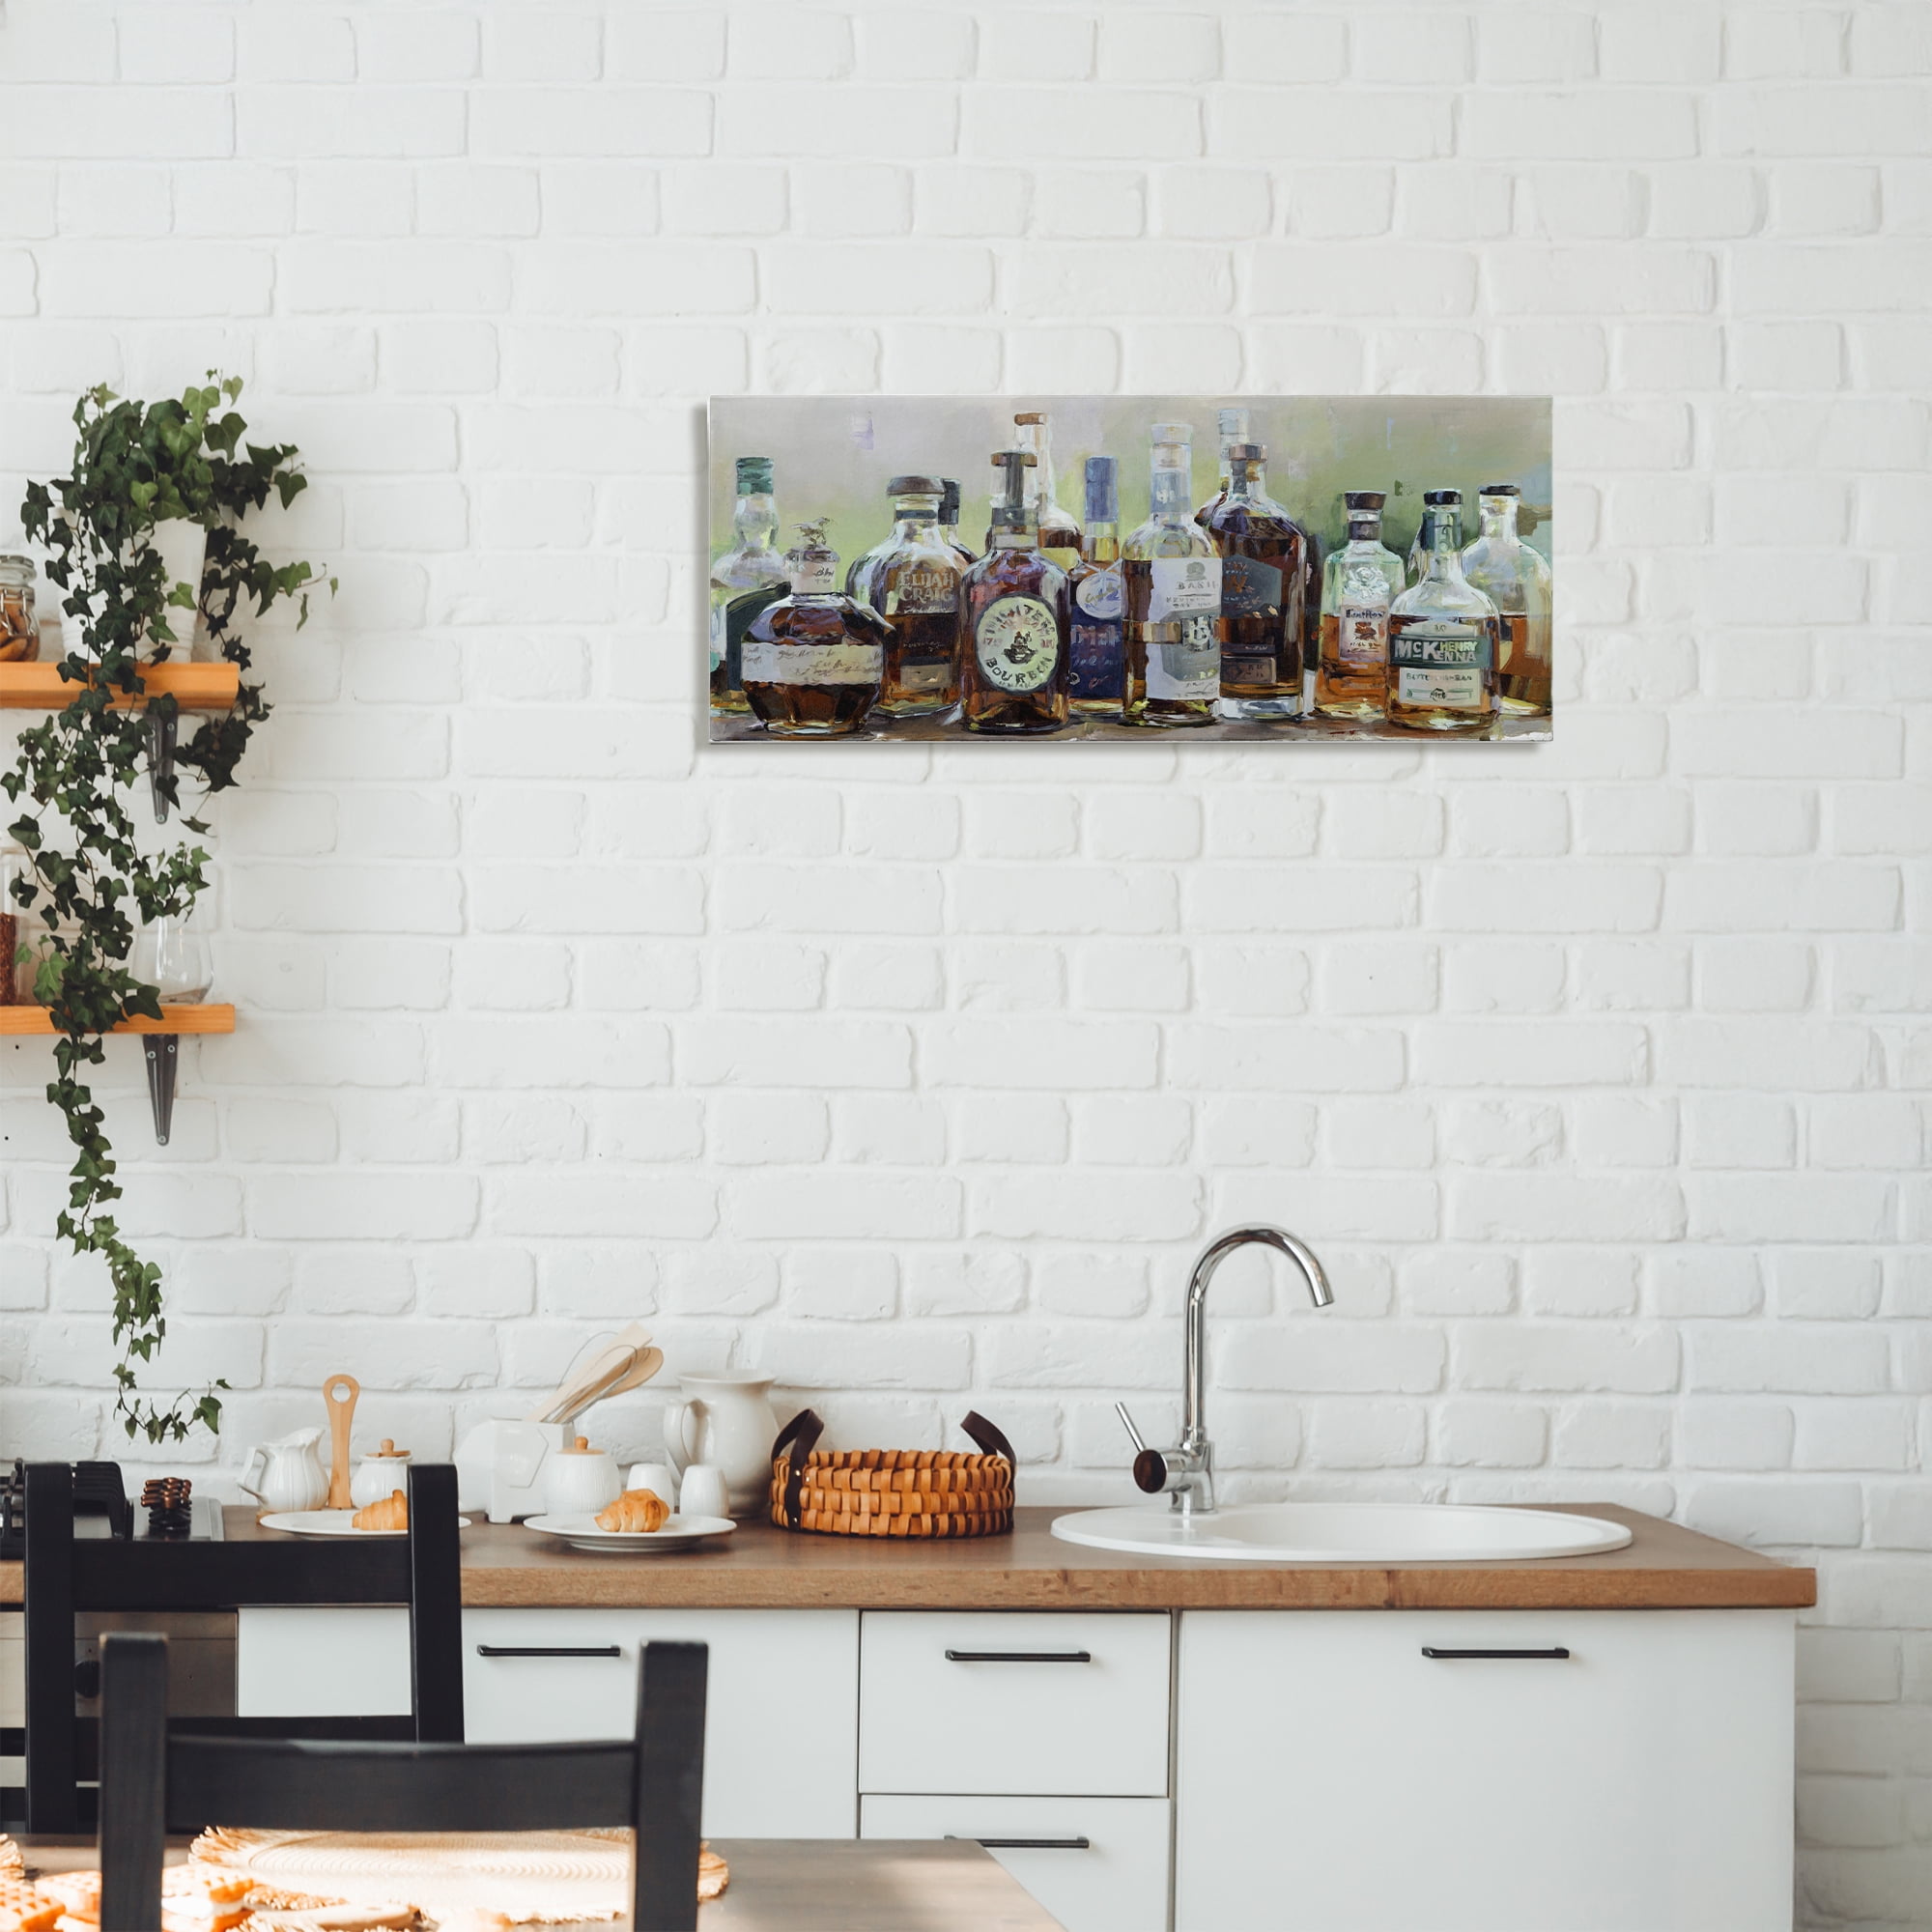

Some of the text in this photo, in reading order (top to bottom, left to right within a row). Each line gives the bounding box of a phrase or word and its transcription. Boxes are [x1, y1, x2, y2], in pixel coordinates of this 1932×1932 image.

[898, 586, 952, 604] CRAIG
[1439, 640, 1478, 652] HENRY
[985, 657, 1053, 684] BOURBON
